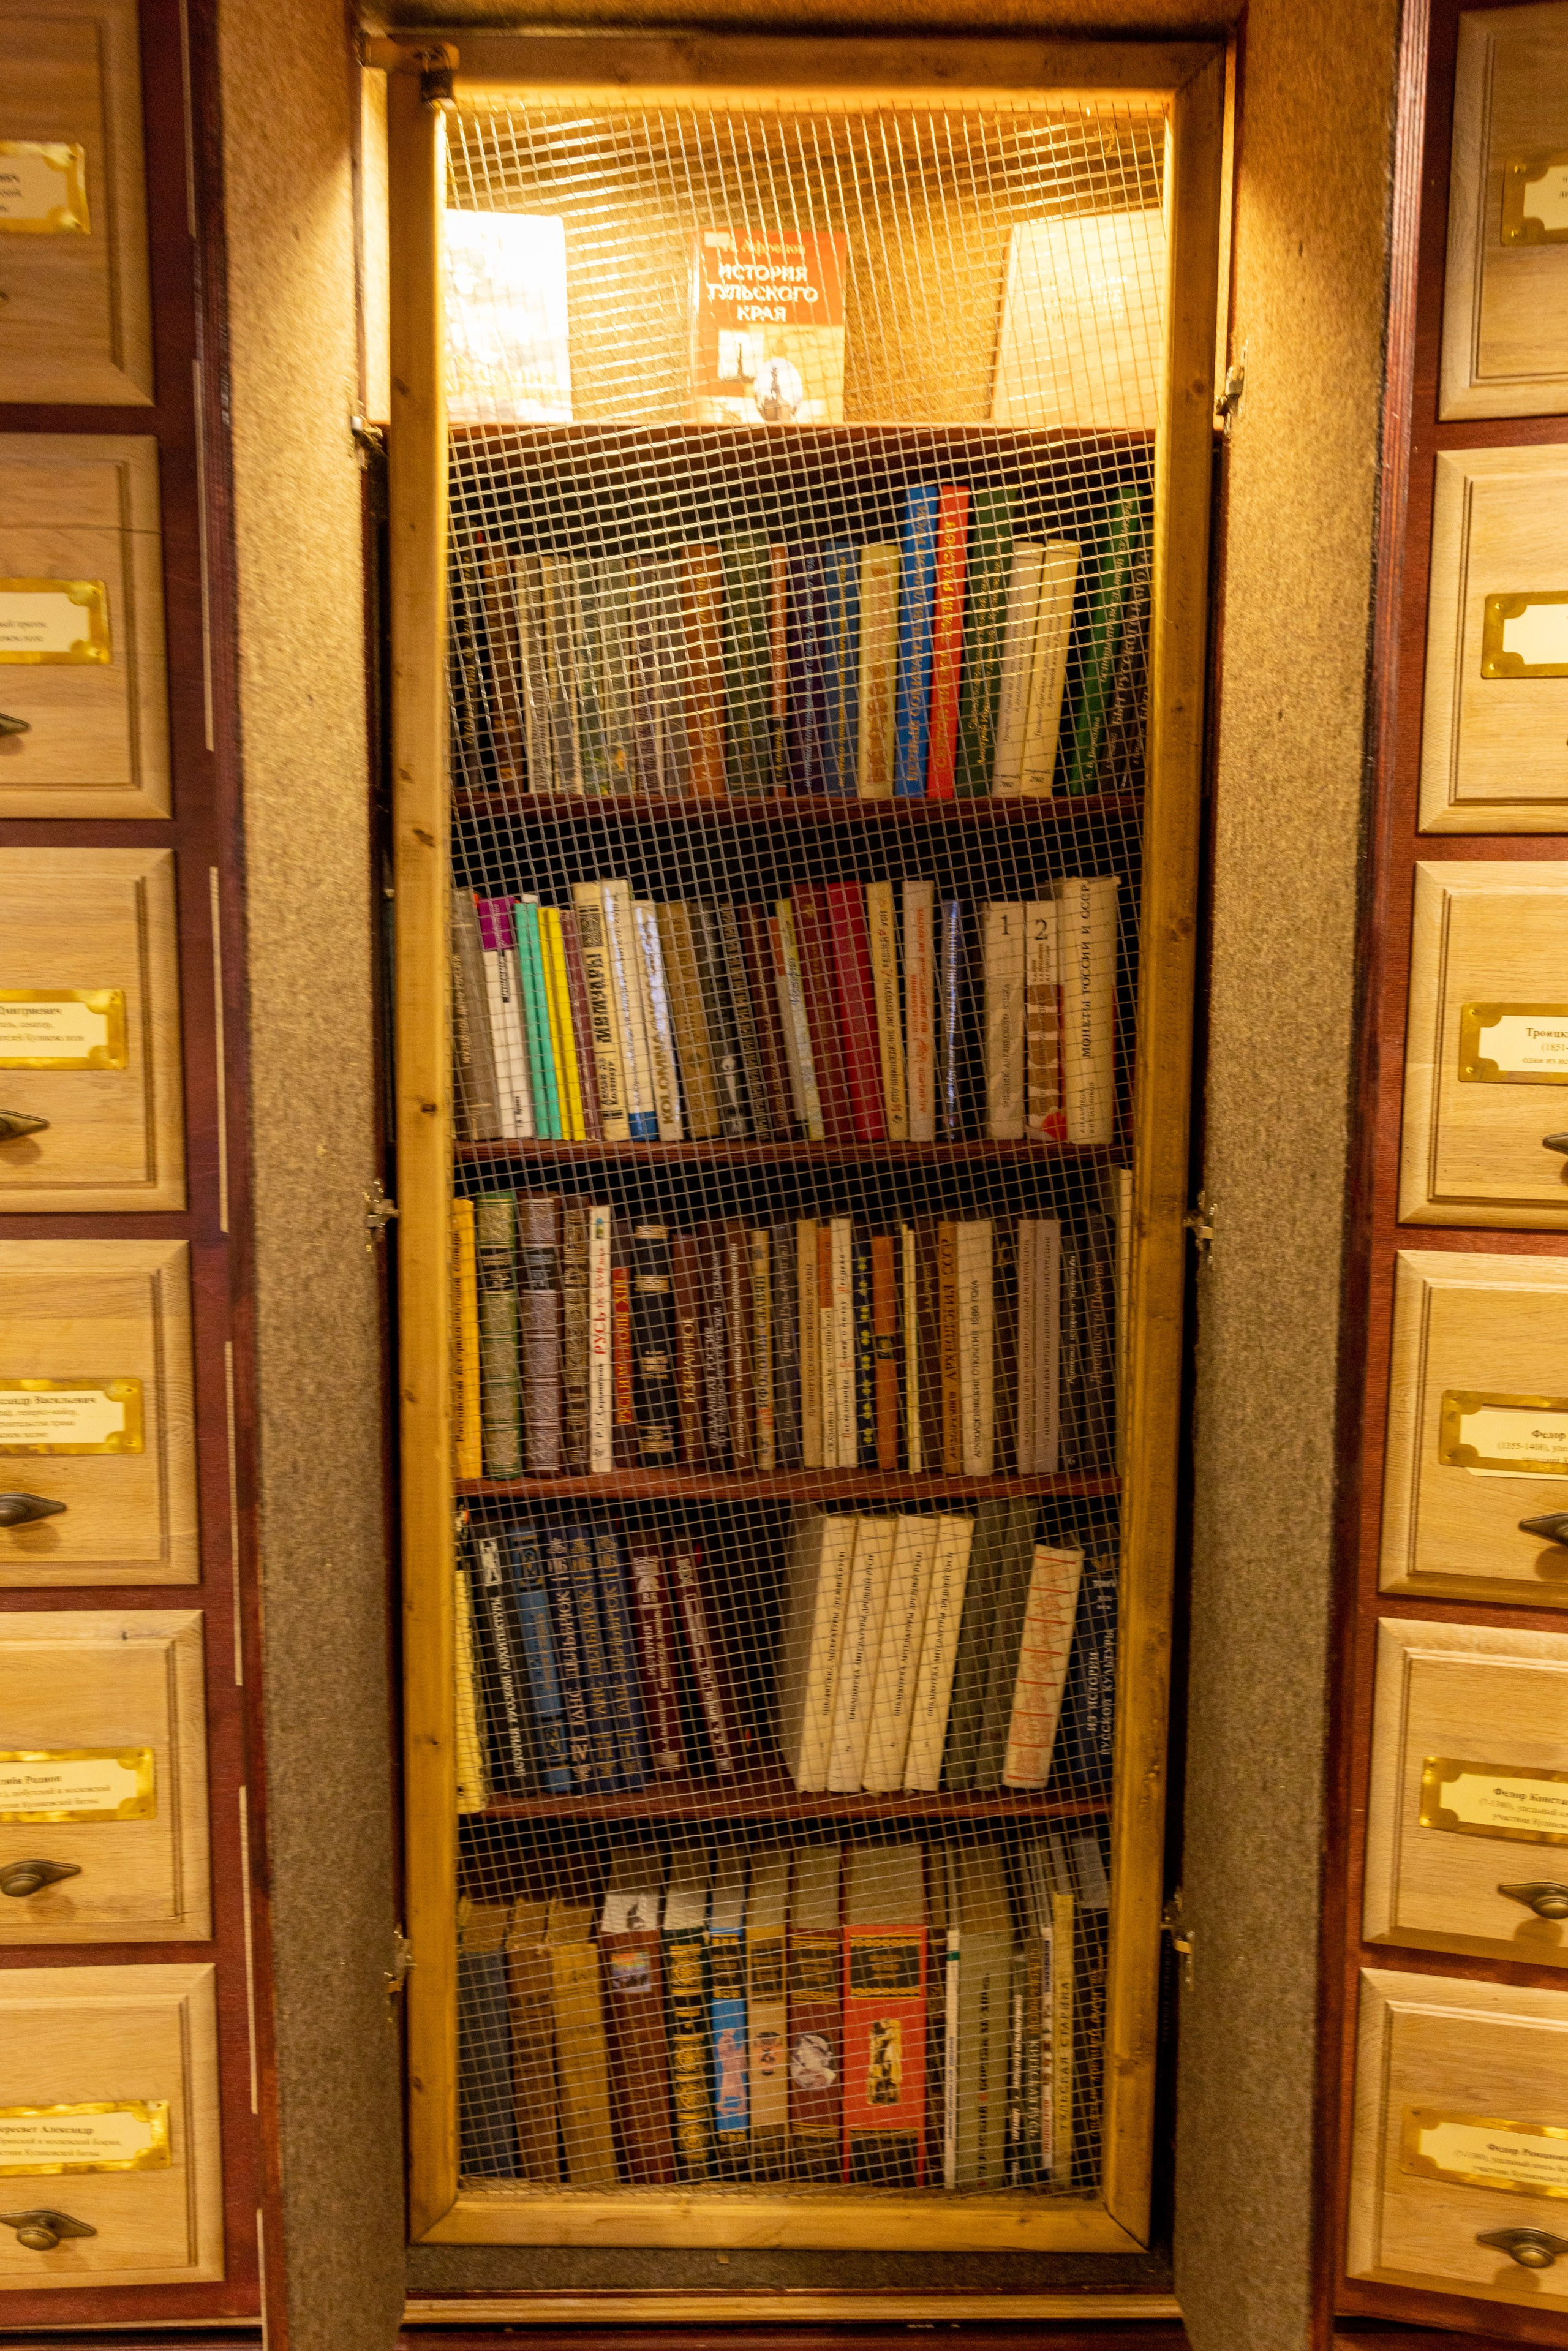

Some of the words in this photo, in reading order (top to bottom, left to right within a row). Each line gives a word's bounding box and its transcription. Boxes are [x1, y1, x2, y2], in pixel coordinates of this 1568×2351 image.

[707, 284, 819, 303] ТУЛЬСКОГО
[718, 264, 808, 282] ИСТОРИЯ
[737, 305, 787, 322] КРАЯ
[914, 506, 927, 545] РУСИ
[942, 521, 956, 592] РУССКОЙ
[909, 624, 923, 717] СОБИРАТЕЛЬ
[1116, 614, 1138, 690] РУССКОГО
[1112, 697, 1126, 725] БЫТ
[907, 720, 921, 781] ПЕРВЫЙ
[1000, 914, 1010, 935] 1
[1080, 884, 1091, 919] СССР
[1035, 919, 1048, 940] 2
[451, 955, 464, 989] РОССИИ
[1080, 942, 1091, 994] РОССИИ
[458, 1019, 472, 1063] МУЗЕЙНОЕ
[1080, 999, 1091, 1057] МОНЕТЫ
[653, 1036, 674, 1125] KOLOMNA
[941, 1239, 954, 1276] СССР
[614, 1280, 628, 1304] XIII
[755, 1275, 766, 1329] СЛАВЯН
[969, 1280, 979, 1303] ГОДА
[1090, 1262, 1105, 1308] Поочья
[593, 1312, 607, 1354] РУСЬ
[615, 1311, 630, 1376] МОНГОЛЫ
[943, 1285, 957, 1381] АРХЕОЛОГИЯ
[971, 1331, 981, 1376] ОТКРЫТИЯ
[1090, 1313, 1106, 1384] Древности
[681, 1316, 696, 1403] ИЗБРАННОЕ
[616, 1395, 632, 1422] РУСЬ
[972, 1381, 982, 1458] АРХЕОЛОГИЧЕСКИЕ
[836, 1551, 846, 1572] РУСИ
[865, 1554, 875, 1576] РУСИ
[913, 1551, 923, 1572] РУСИ
[944, 1552, 954, 1572] РУСИ
[832, 1574, 843, 1610] ДРЕВНЕЙ
[860, 1577, 872, 1614] ДРЕВНЕЙ
[907, 1574, 921, 1610] ДРЕВНЕЙ
[938, 1575, 951, 1611] ДРЕВНЕЙ
[489, 1597, 511, 1671] АРХИТЕКТУРЫ
[556, 1589, 579, 1679] ДЕЛЬБРЮК
[579, 1589, 603, 1675] ДЕЛЬБРЮК
[603, 1586, 627, 1673] ДЕЛЬБРЮК
[642, 1625, 657, 1675] ИСТОРИЯ
[827, 1612, 840, 1662] ЛИТЕРАТУРЫ
[854, 1615, 867, 1666] ЛИТЕРАТУРЫ
[900, 1612, 915, 1663] ЛИТЕРАТУРЫ
[932, 1612, 947, 1663] ЛИТЕРАТУРЫ
[1087, 1651, 1100, 1710] ИСТОРИИ
[1101, 1629, 1115, 1692] КУЛЬТУРЫ
[501, 1675, 518, 1723] РУССКОЙ
[567, 1686, 587, 1726] ГАНС
[822, 1666, 835, 1716] БИБЛИОТЕКА
[848, 1669, 861, 1720] БИБЛИОТЕКА
[893, 1666, 907, 1717] БИБЛИОТЕКА
[926, 1666, 940, 1717] БИБЛИОТЕКА
[1087, 1715, 1099, 1732] ИЗ
[1100, 1699, 1114, 1756] РУССКОЙ
[508, 1727, 526, 1777] ИСТОРИЯ
[1059, 1982, 1070, 2048] СТАРИНА
[1060, 2056, 1070, 2132] ТУЛЬСКАЯ
[41, 2126, 94, 2135] Александр
